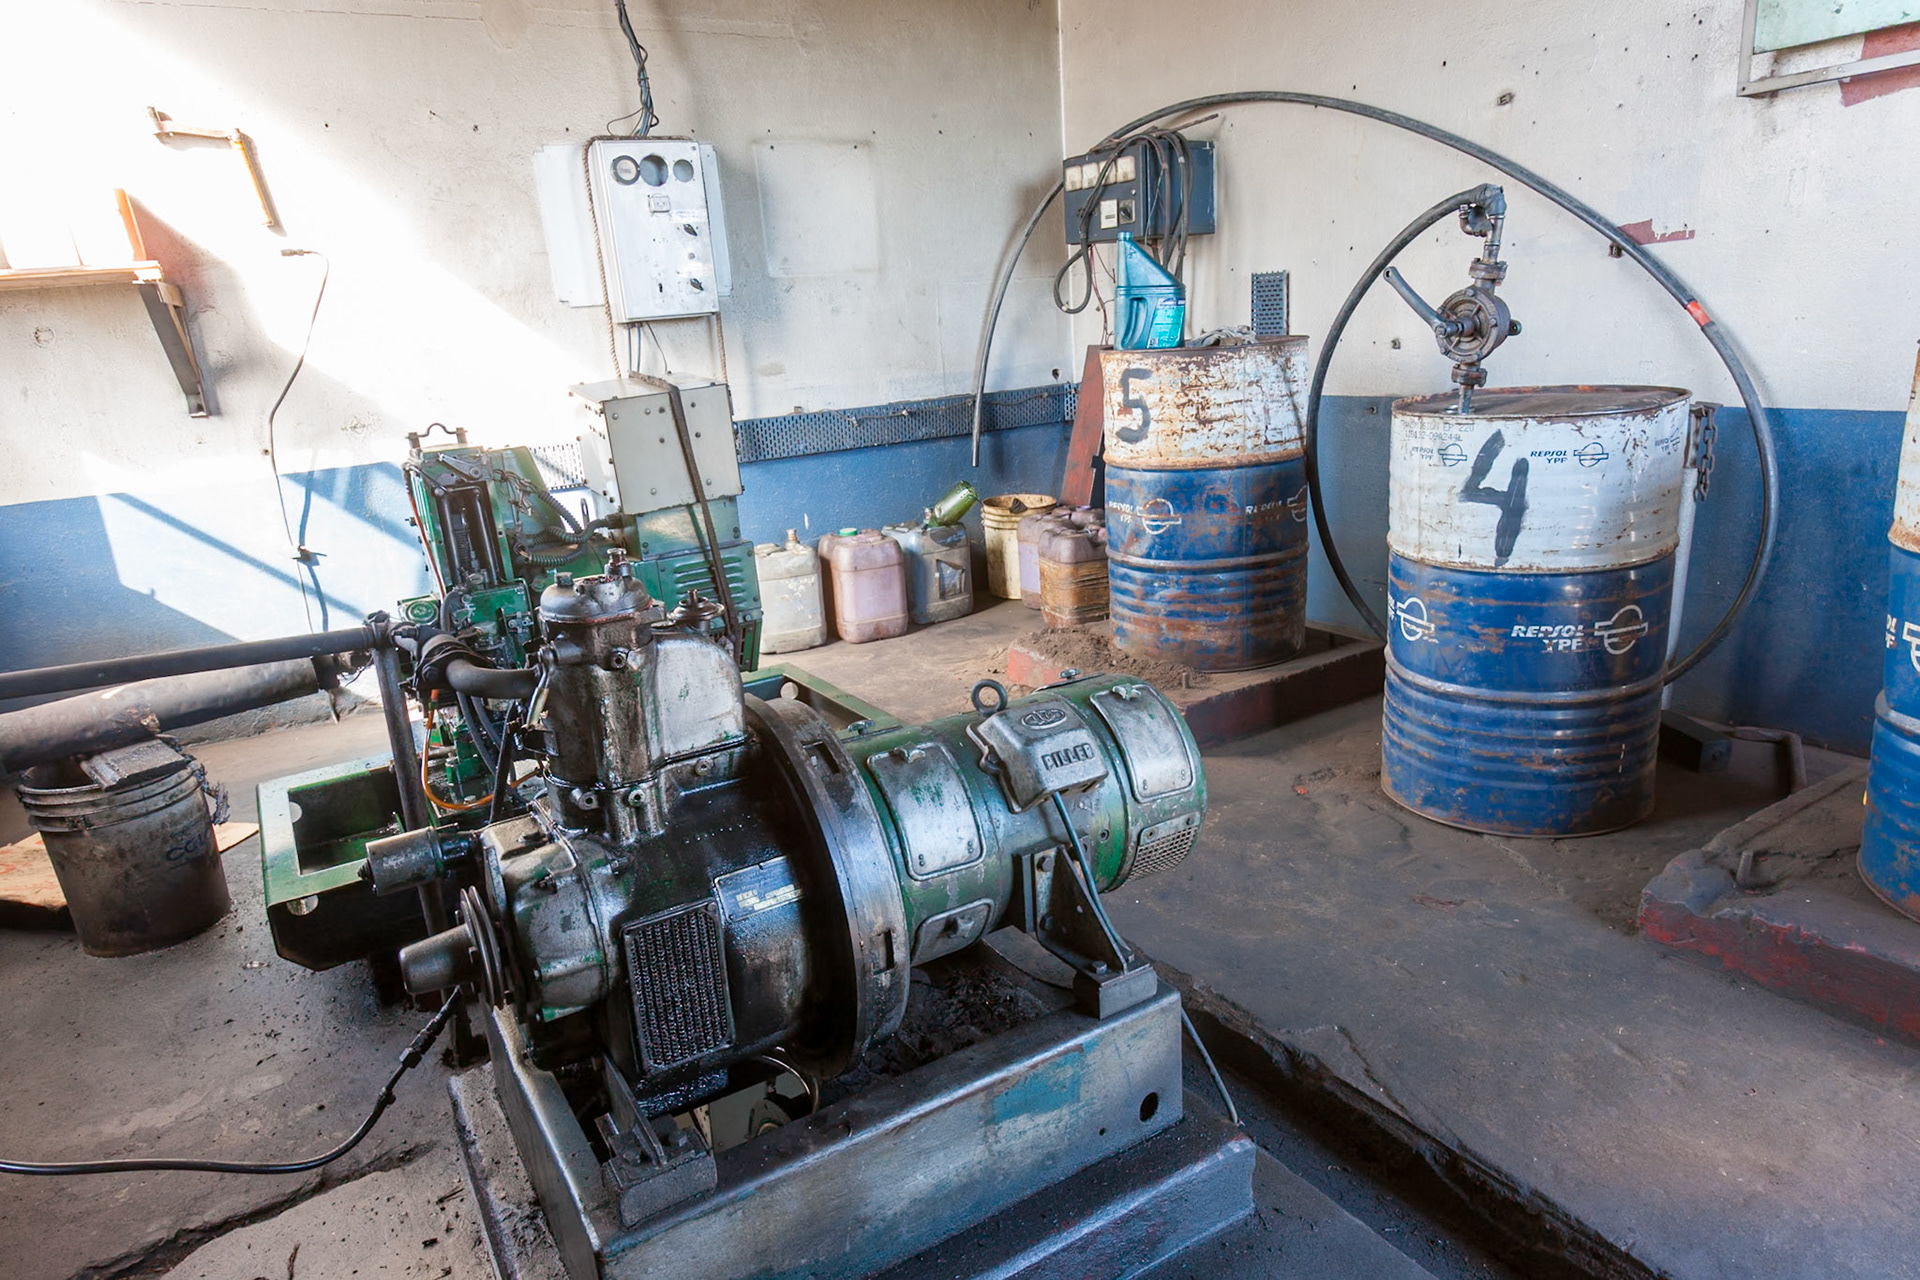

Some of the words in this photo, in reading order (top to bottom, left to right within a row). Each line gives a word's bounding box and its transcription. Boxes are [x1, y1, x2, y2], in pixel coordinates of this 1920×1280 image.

[1115, 367, 1153, 444] 5
[1459, 428, 1529, 568] 4
[1511, 624, 1584, 638] REPSOL
[1542, 638, 1583, 652] YPF
[1041, 743, 1095, 771] PILLER
